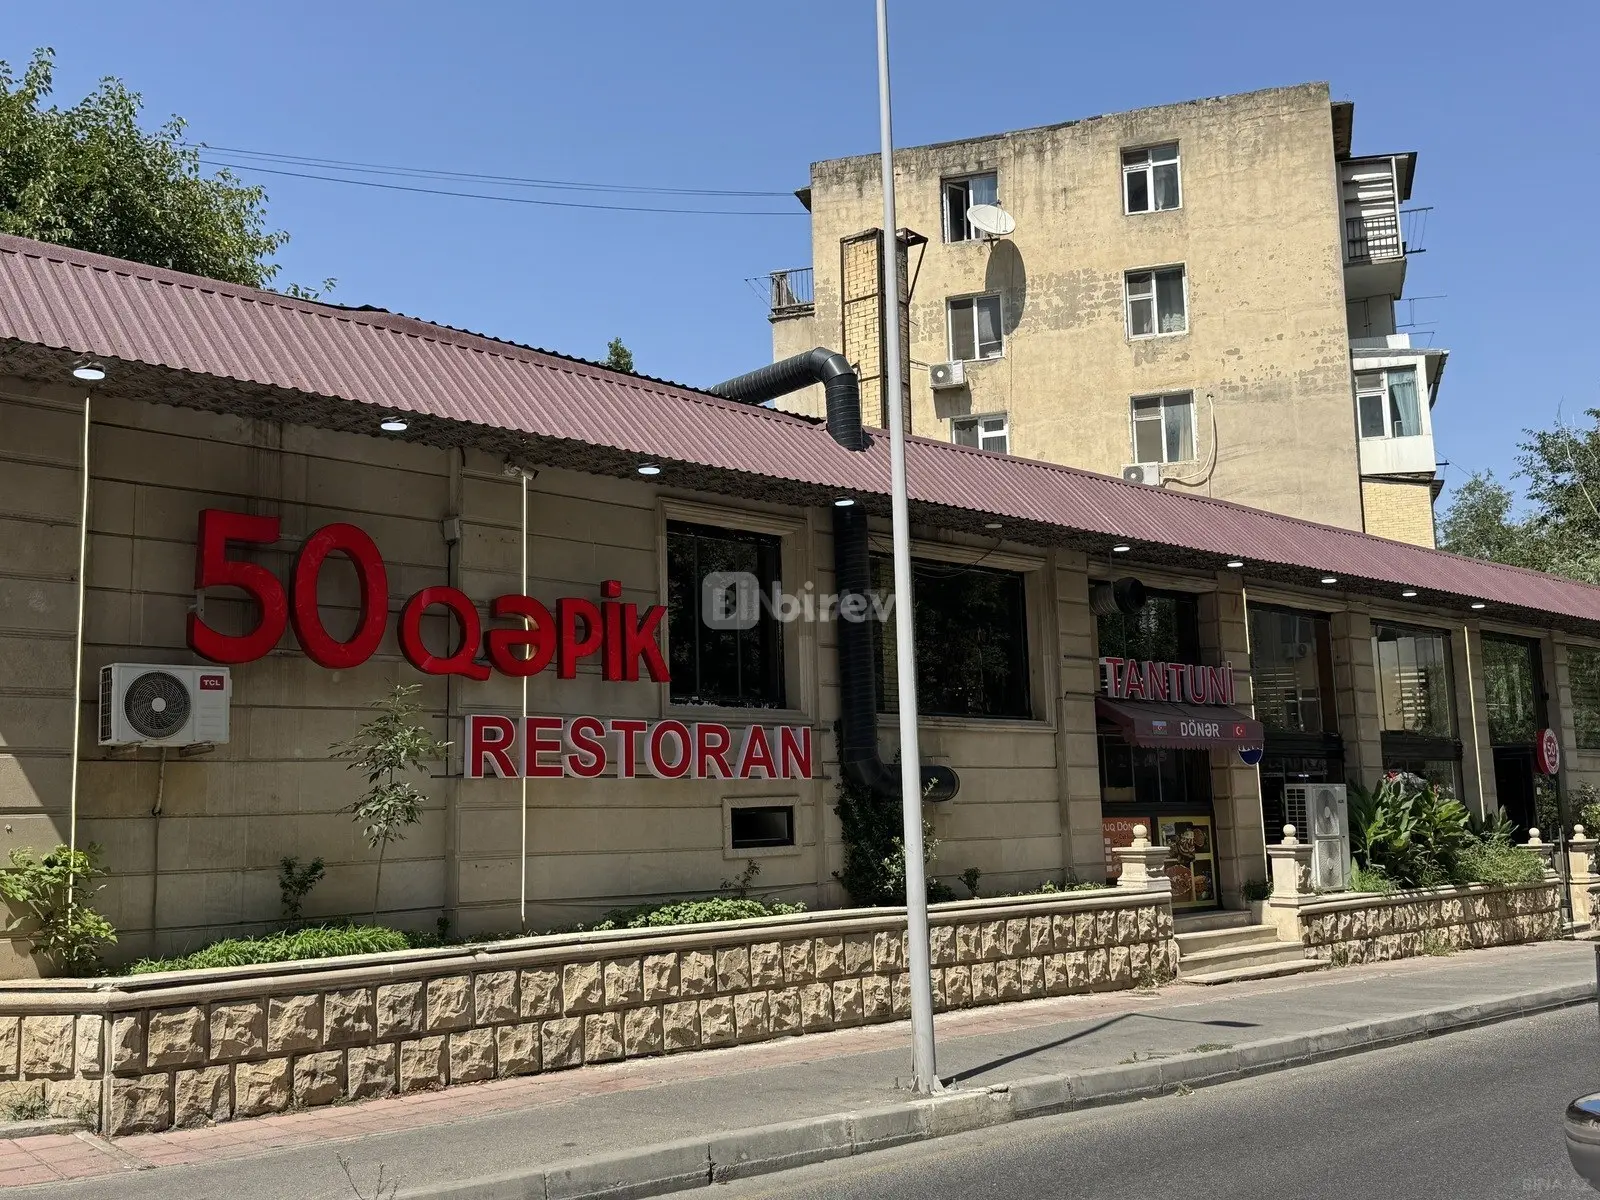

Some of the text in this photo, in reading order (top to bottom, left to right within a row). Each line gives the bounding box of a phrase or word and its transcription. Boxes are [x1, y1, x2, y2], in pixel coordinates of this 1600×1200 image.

[185, 508, 389, 670] 50
[1100, 657, 1236, 706] TANTUNİ
[465, 714, 812, 780] RESTORAN
[1180, 719, 1220, 738] DÖNƏR
[1546, 742, 1556, 755] 50
